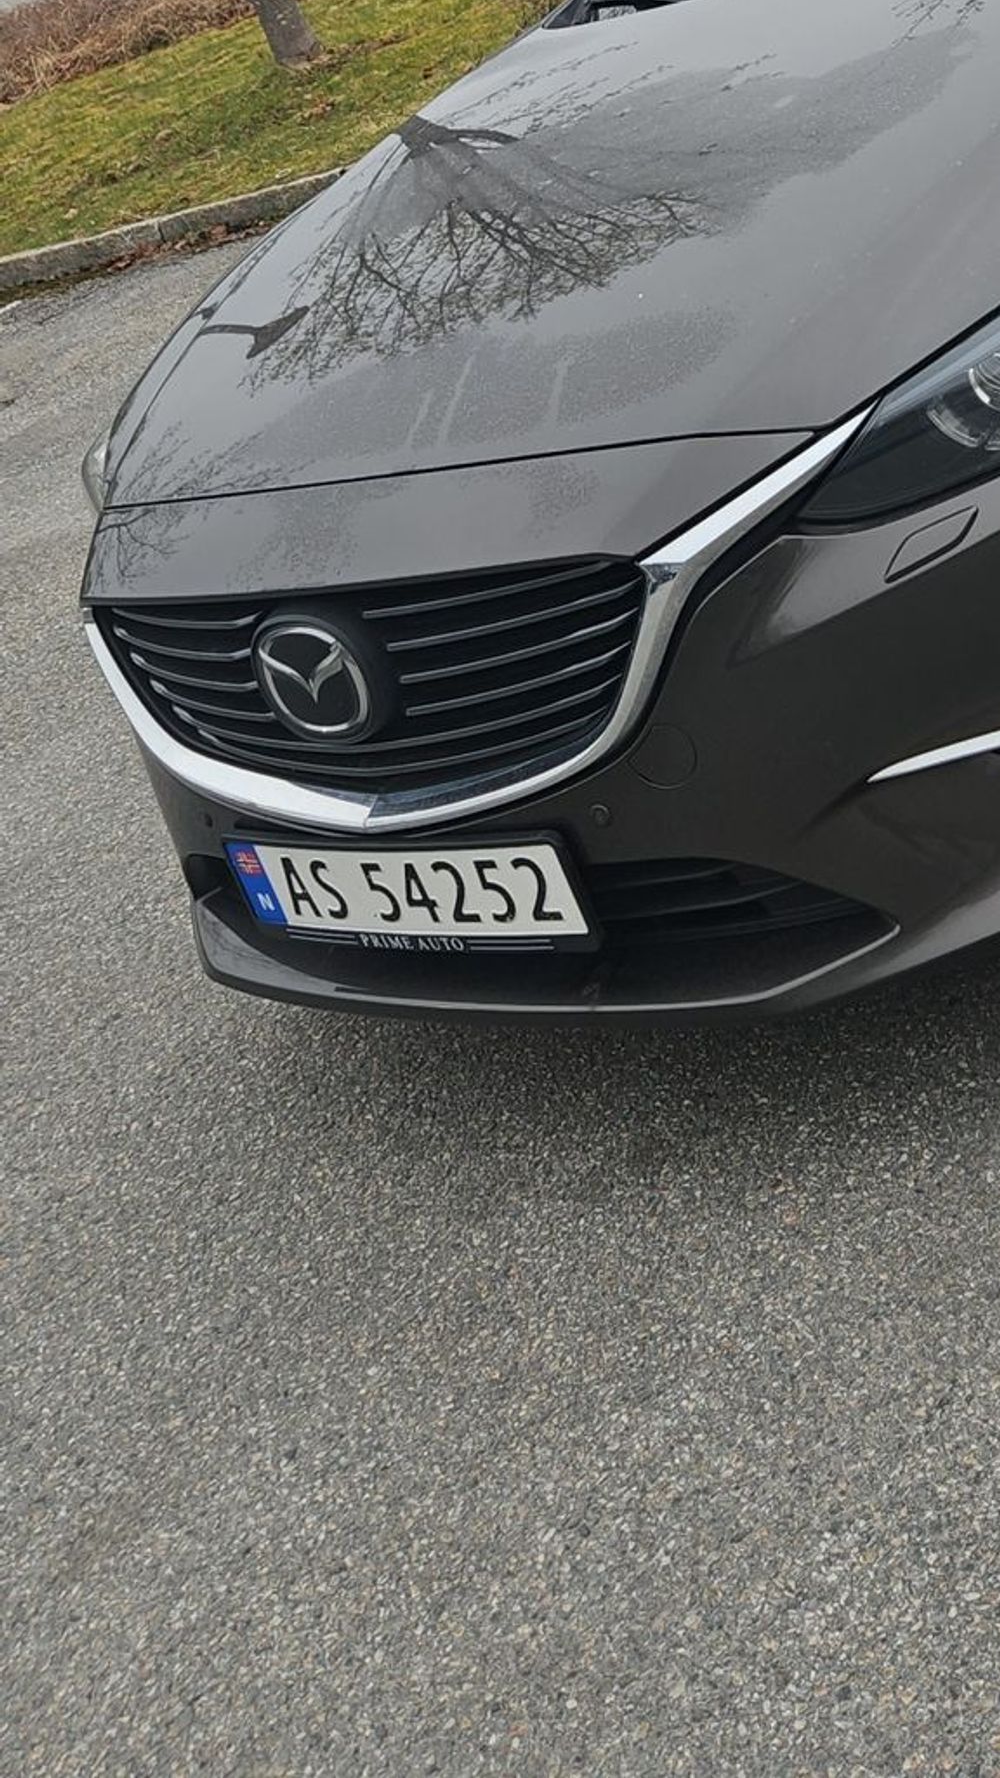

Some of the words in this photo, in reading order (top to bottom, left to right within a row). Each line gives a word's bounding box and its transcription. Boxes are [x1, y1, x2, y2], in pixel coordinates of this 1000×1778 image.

[279, 856, 349, 920] AS
[359, 857, 564, 923] 54252
[257, 892, 276, 912] N
[358, 932, 415, 951] PRIME
[417, 936, 465, 952] AUTO
